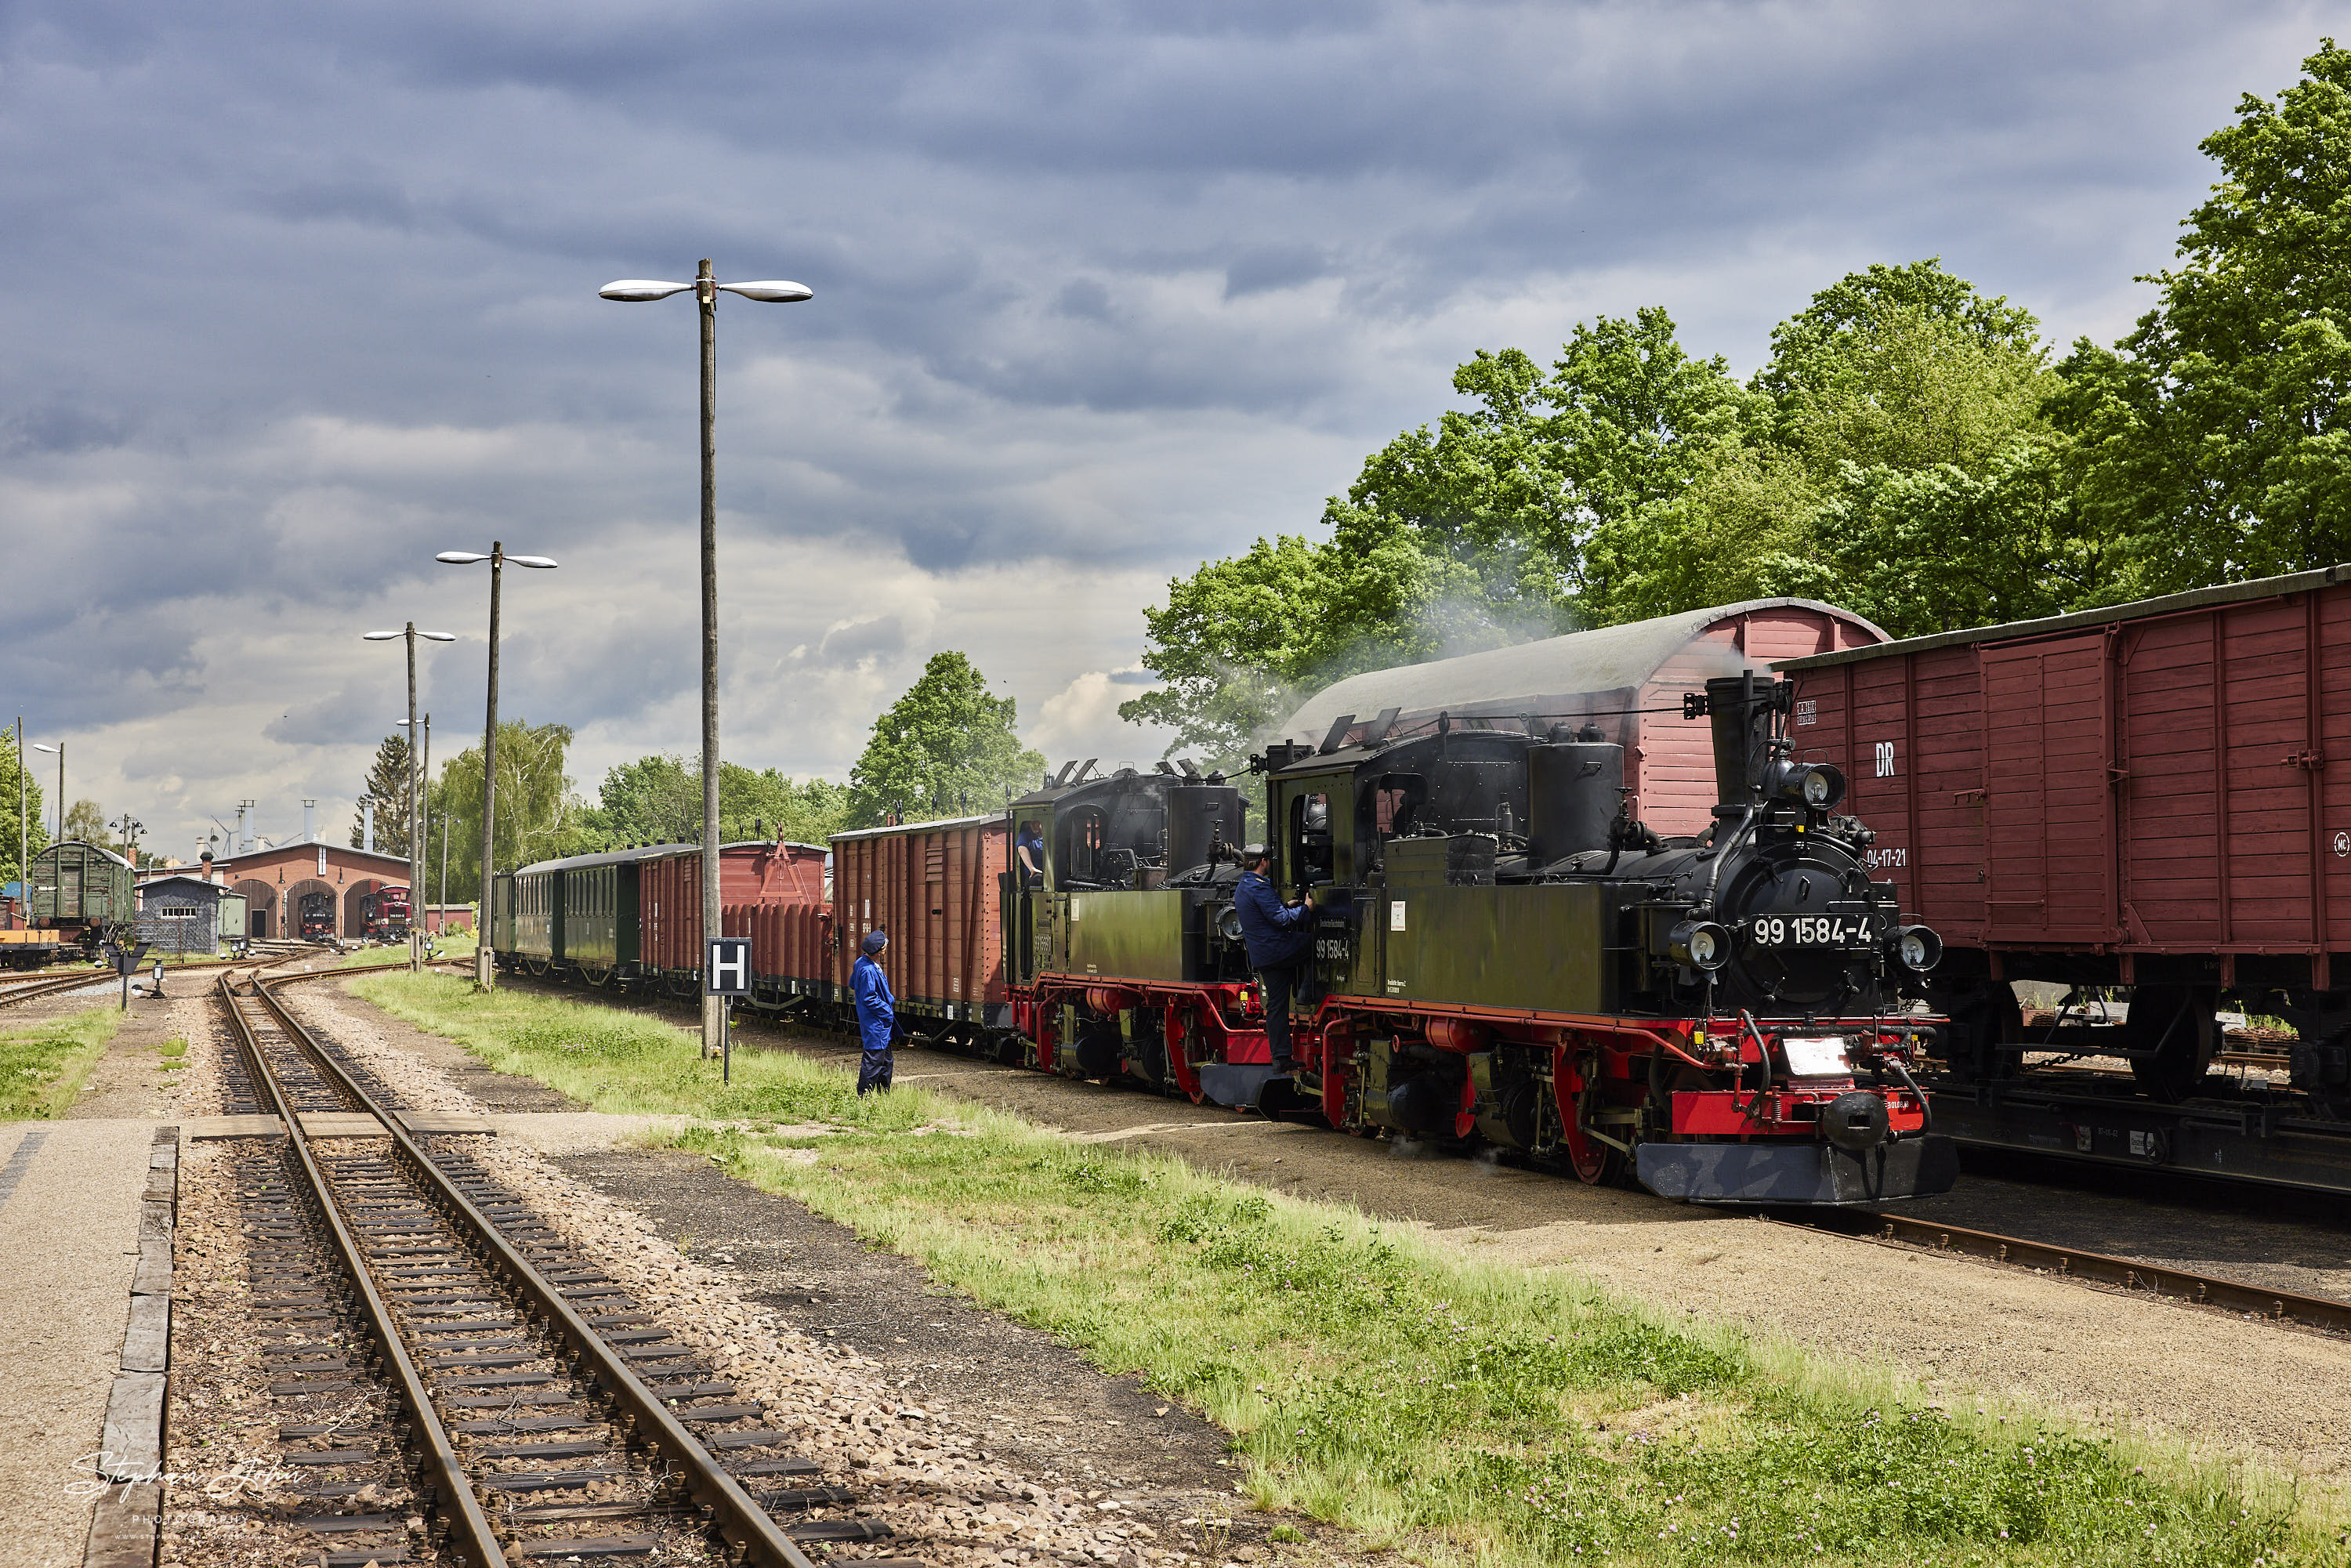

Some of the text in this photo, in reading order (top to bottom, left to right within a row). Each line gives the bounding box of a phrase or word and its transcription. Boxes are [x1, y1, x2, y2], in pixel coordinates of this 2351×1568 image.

[1875, 741, 1895, 777] DR
[1867, 848, 1906, 867] 04-17-21
[1755, 917, 1872, 944] 99 1584-4
[1317, 940, 1349, 960] 99 1584-4
[712, 944, 745, 990] H
